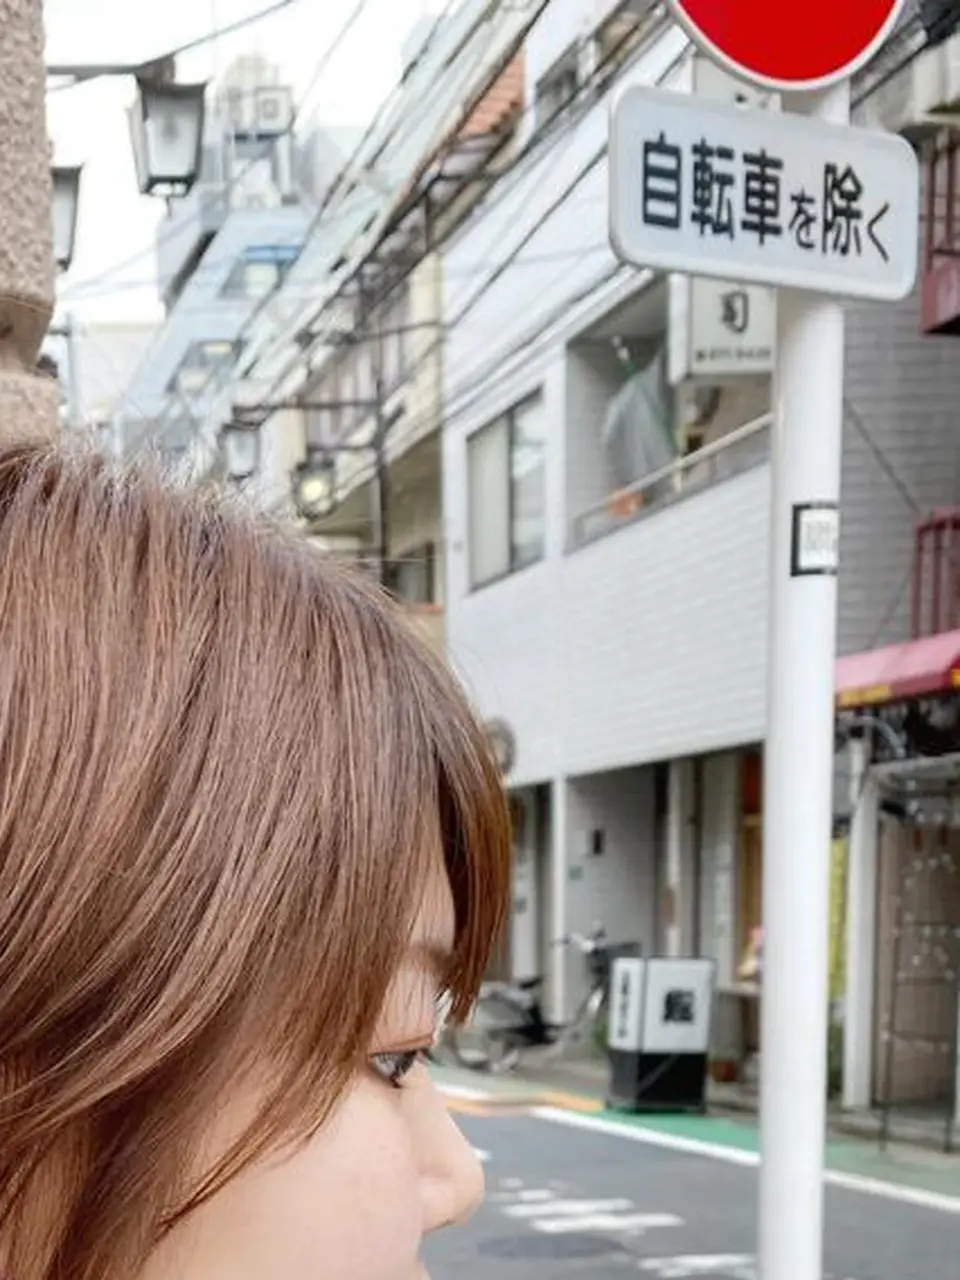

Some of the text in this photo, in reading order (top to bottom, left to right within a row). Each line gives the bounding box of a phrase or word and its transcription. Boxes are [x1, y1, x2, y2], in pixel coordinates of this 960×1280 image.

[642, 131, 890, 262] 自転車を除く
